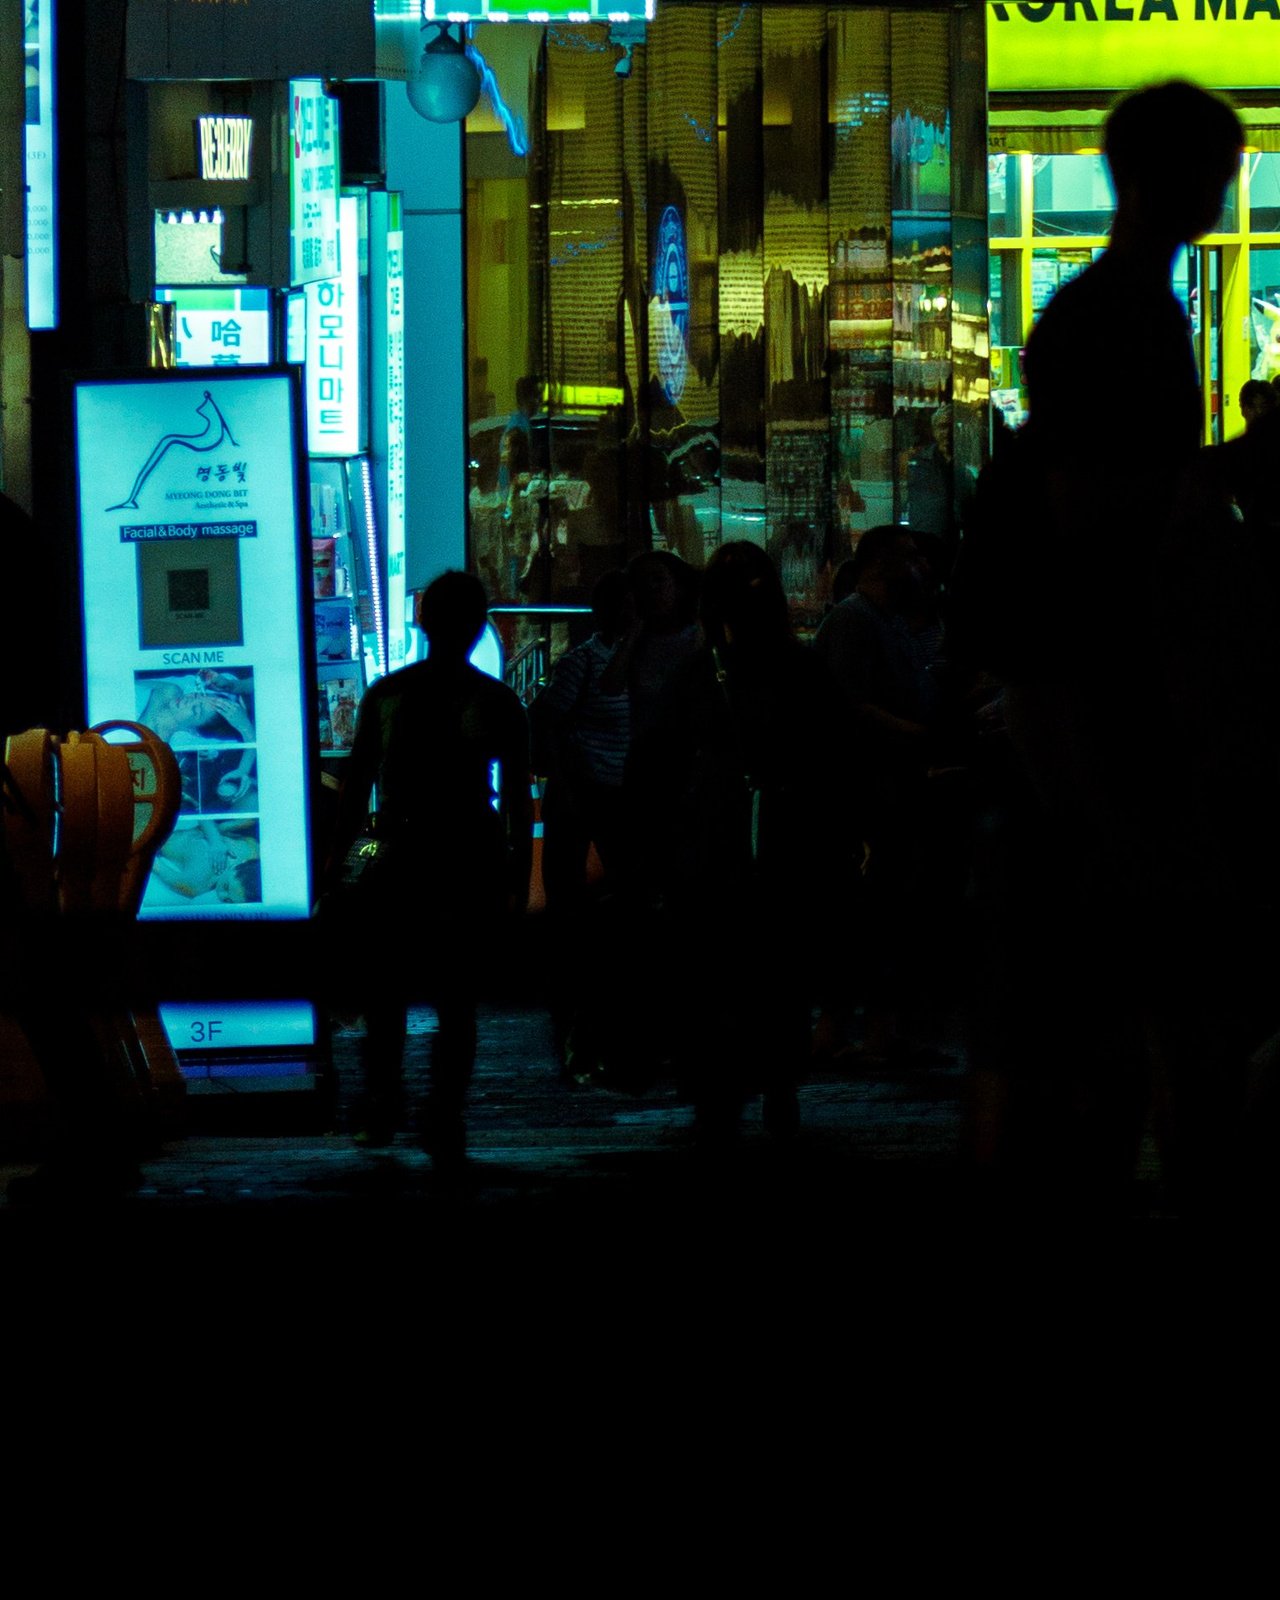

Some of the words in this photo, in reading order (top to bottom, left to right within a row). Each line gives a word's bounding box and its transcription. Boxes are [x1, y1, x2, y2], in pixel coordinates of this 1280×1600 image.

[317, 281, 346, 435] 하모니마트
[196, 461, 248, 483] 명동빛
[165, 490, 204, 501] MYEONG
[205, 489, 232, 499] DONG
[233, 488, 249, 498] BIT
[202, 522, 254, 537] massage
[163, 652, 200, 665] SCAN
[204, 651, 225, 664] ME
[190, 1020, 223, 1043] 3F
